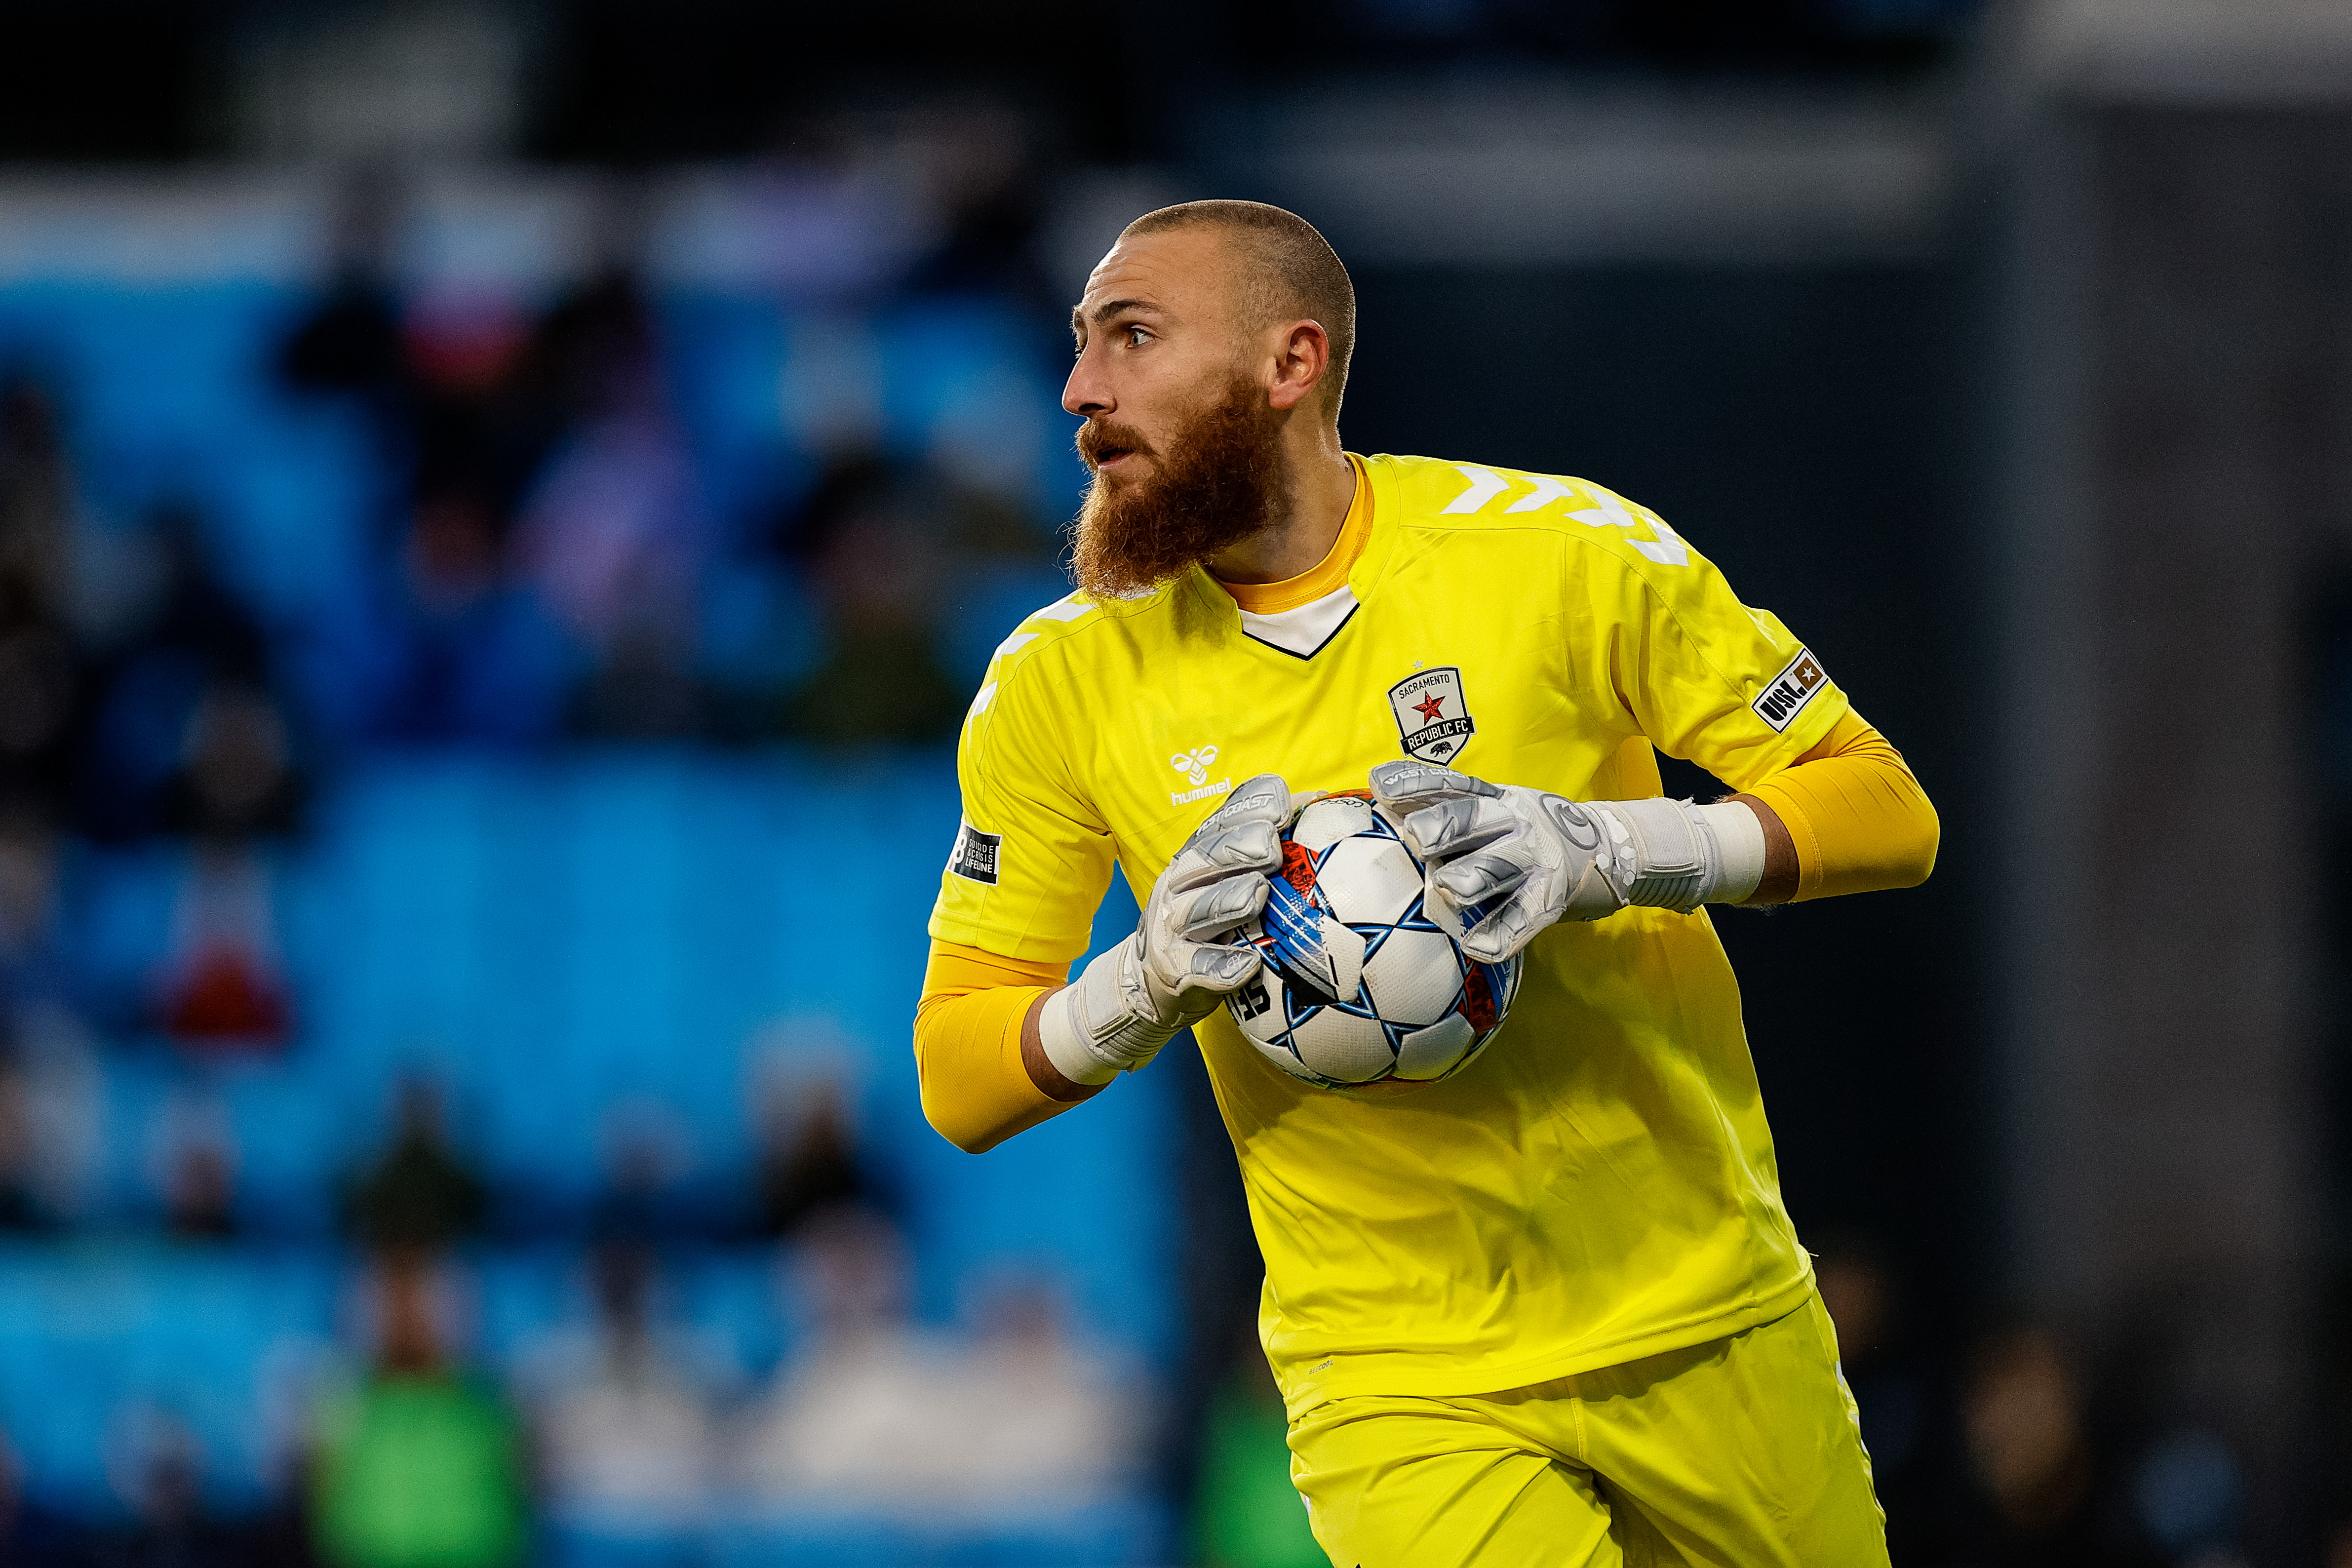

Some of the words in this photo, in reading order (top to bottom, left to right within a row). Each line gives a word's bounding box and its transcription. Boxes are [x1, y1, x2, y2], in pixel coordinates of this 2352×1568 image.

[1399, 674, 1450, 699] SACRAMENTO
[1759, 679, 1808, 721] USL
[1408, 723, 1453, 750] REPUBLIC
[1455, 719, 1468, 733] FC
[1384, 768, 1426, 785] WEST
[1171, 777, 1232, 806] hummel
[1224, 794, 1274, 818] COAST
[969, 838, 994, 854] SUICIDE
[965, 857, 993, 873] LIFELINE
